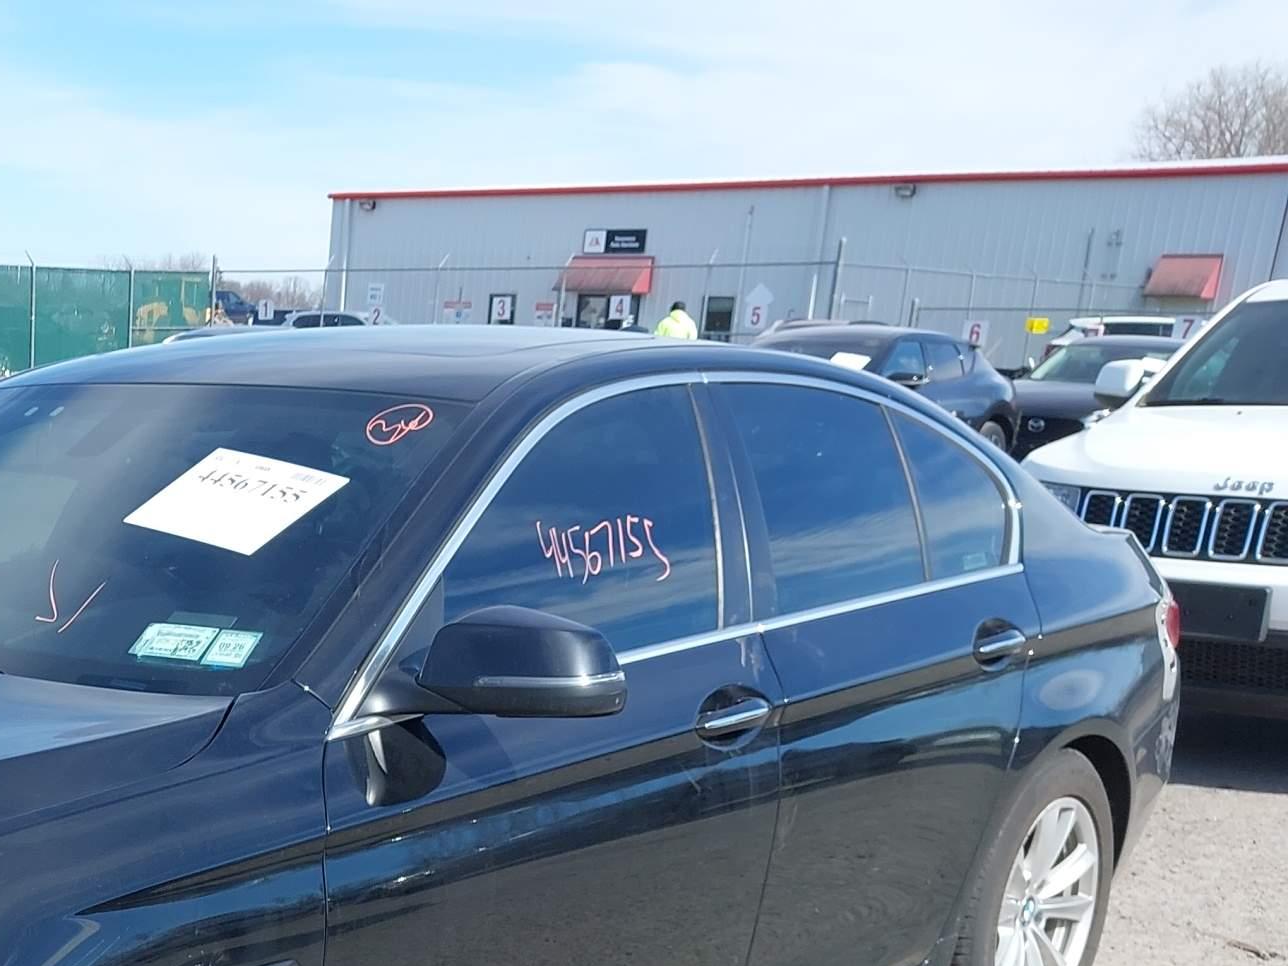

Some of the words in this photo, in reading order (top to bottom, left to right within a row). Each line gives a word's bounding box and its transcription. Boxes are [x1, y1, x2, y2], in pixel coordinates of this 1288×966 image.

[262, 301, 269, 318] 1
[372, 307, 381, 326] 2
[497, 299, 506, 318] 3
[615, 298, 624, 317] 4
[750, 306, 761, 326] 5
[969, 323, 981, 344] 6
[1182, 319, 1195, 340] 7
[198, 469, 309, 503] 44567155
[1213, 475, 1274, 496] Jeep
[536, 514, 671, 585] 44567155
